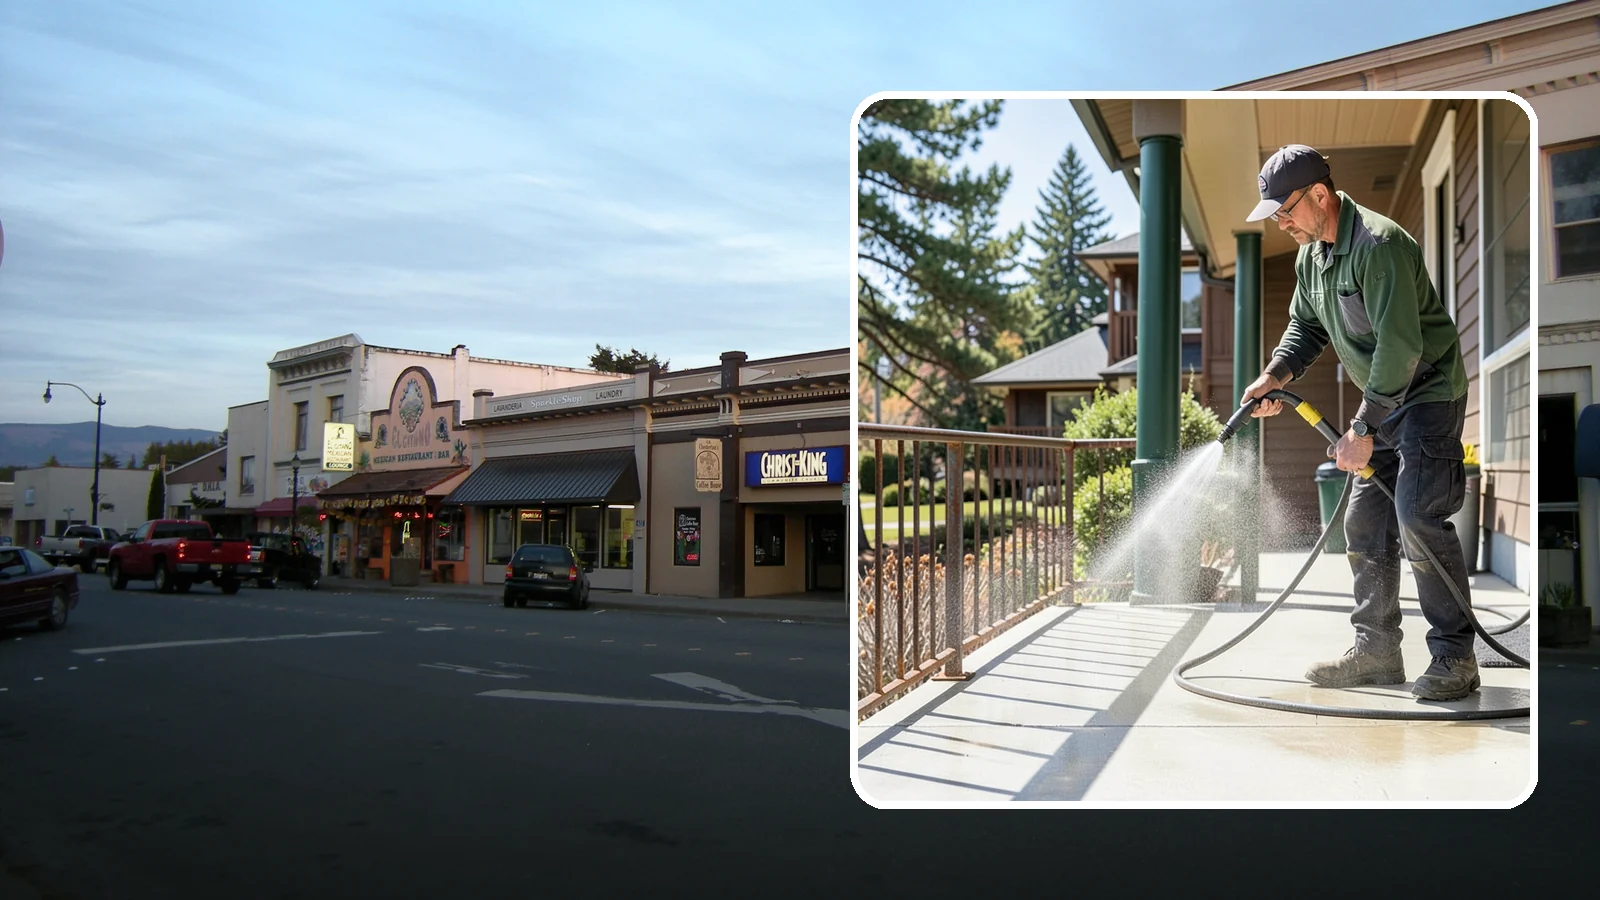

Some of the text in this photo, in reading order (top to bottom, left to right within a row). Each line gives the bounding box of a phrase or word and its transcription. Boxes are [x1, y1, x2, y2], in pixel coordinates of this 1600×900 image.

[493, 402, 522, 412] LAVANDERIA
[561, 394, 582, 404] Shop
[595, 389, 623, 400] LAUNDRY
[373, 454, 396, 464] MEXICAN
[397, 451, 433, 462] RESTAURANT
[438, 450, 450, 459] BAR
[761, 449, 827, 478] CHRIST KING
[697, 480, 721, 489] Coffee House
